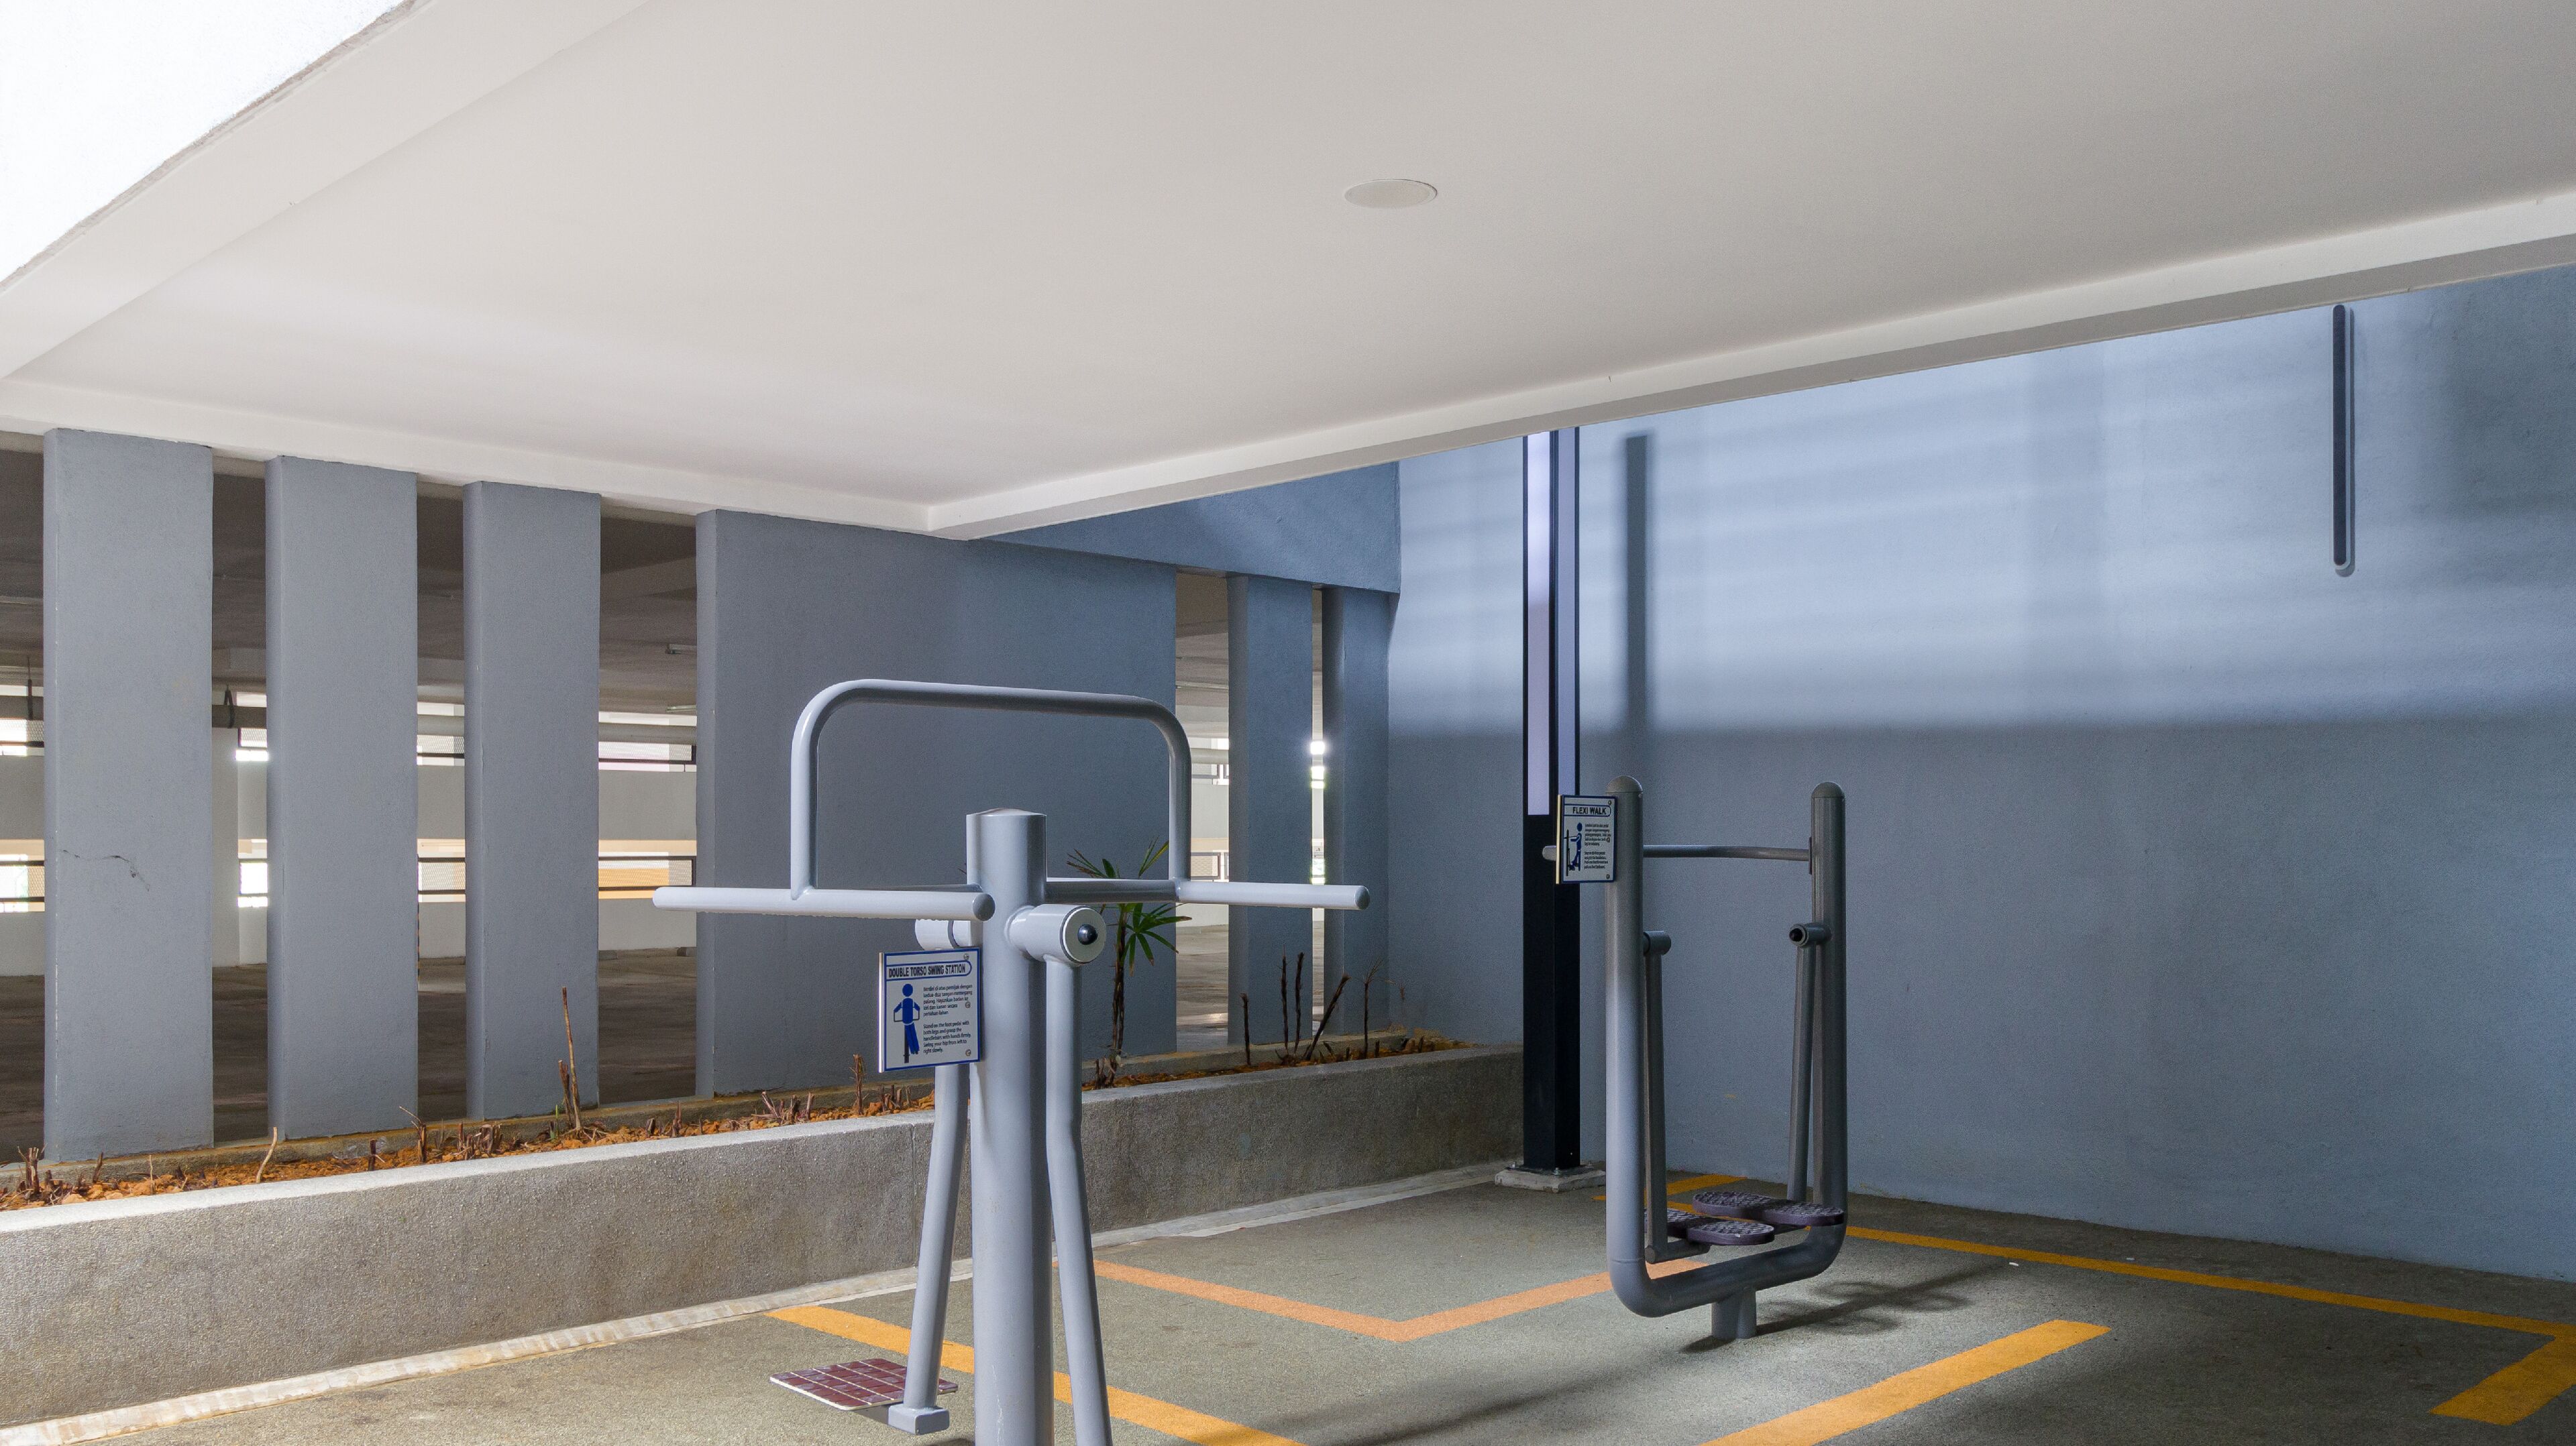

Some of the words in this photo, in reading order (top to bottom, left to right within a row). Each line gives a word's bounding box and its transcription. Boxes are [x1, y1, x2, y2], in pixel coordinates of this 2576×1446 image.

[1590, 807, 1606, 815] WALK
[889, 967, 909, 978] DOUBLE
[910, 966, 927, 977] TORSO
[928, 964, 945, 975] SWING
[945, 964, 965, 974] STATION
